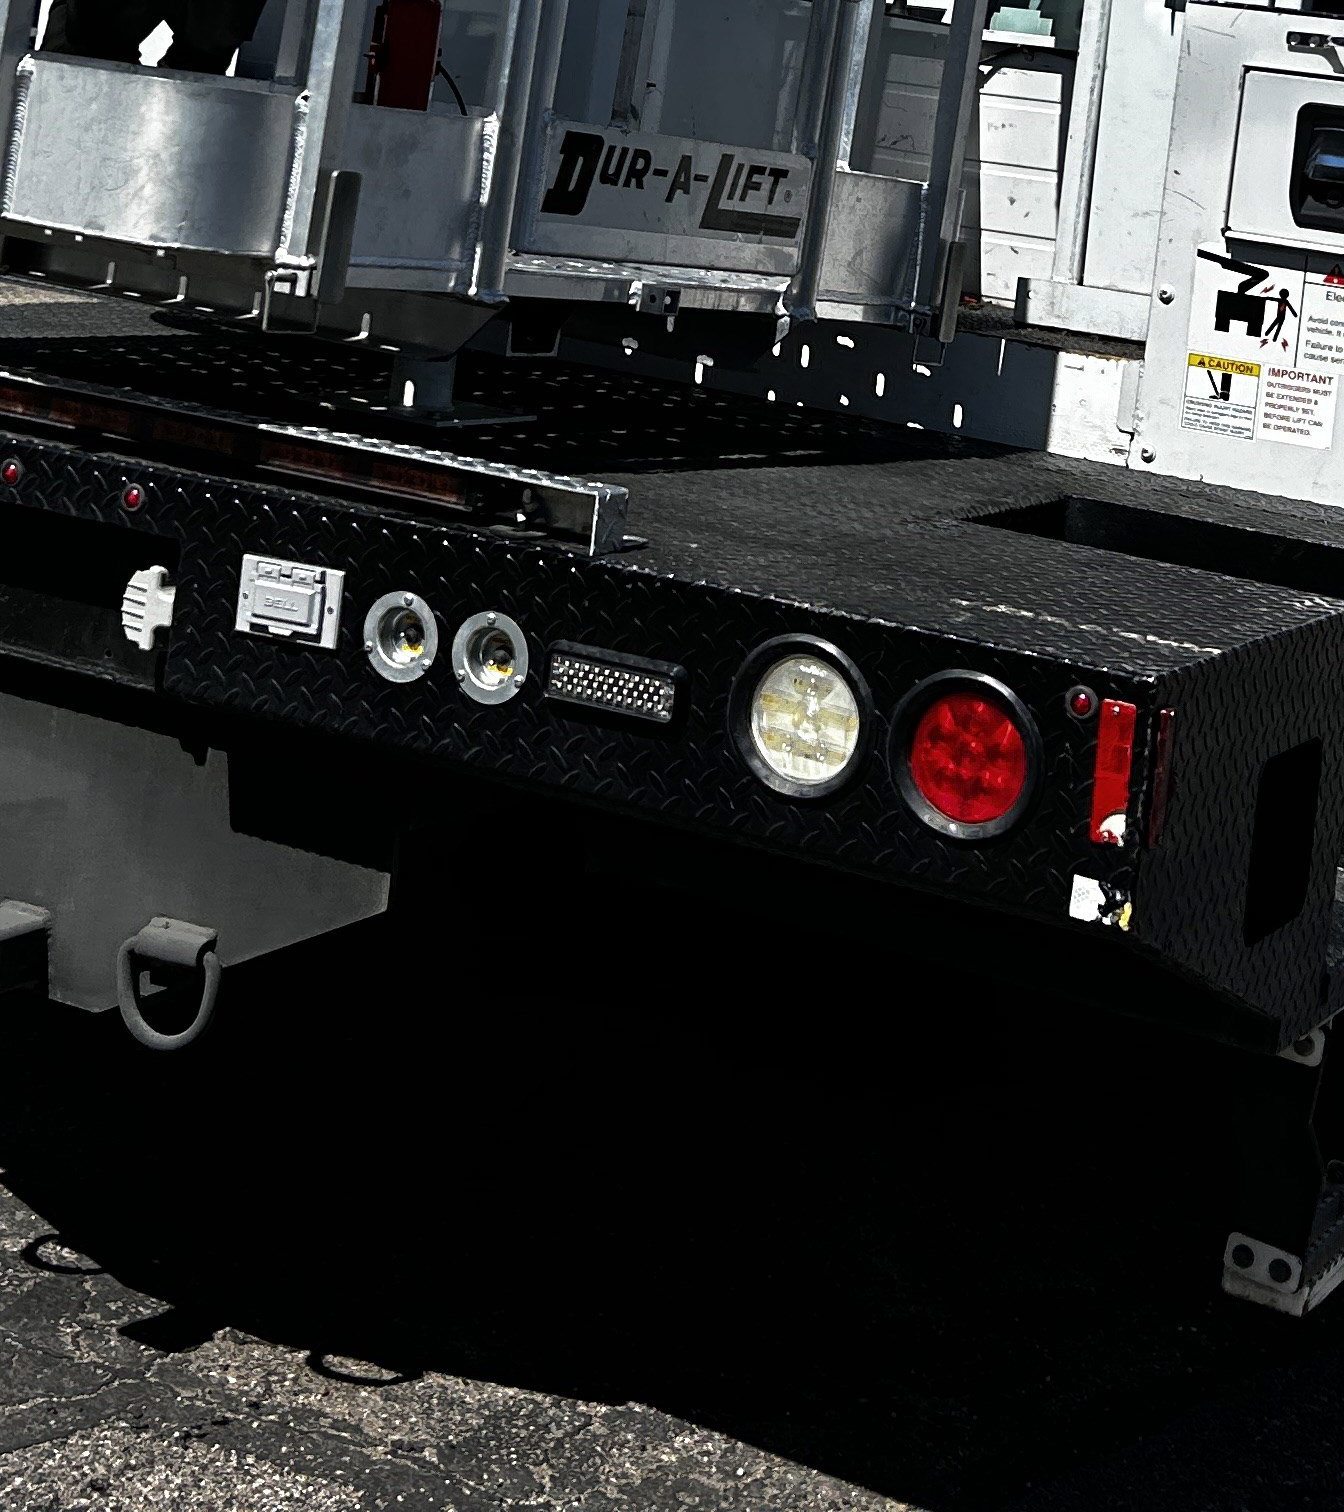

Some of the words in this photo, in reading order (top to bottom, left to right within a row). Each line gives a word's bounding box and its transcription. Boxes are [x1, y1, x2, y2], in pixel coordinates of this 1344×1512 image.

[1305, 339, 1333, 352] Failure
[1336, 344, 1343, 353] to
[1303, 352, 1329, 362] cause
[1207, 358, 1254, 374] CAUTION
[1268, 367, 1334, 385] IMPORTANT
